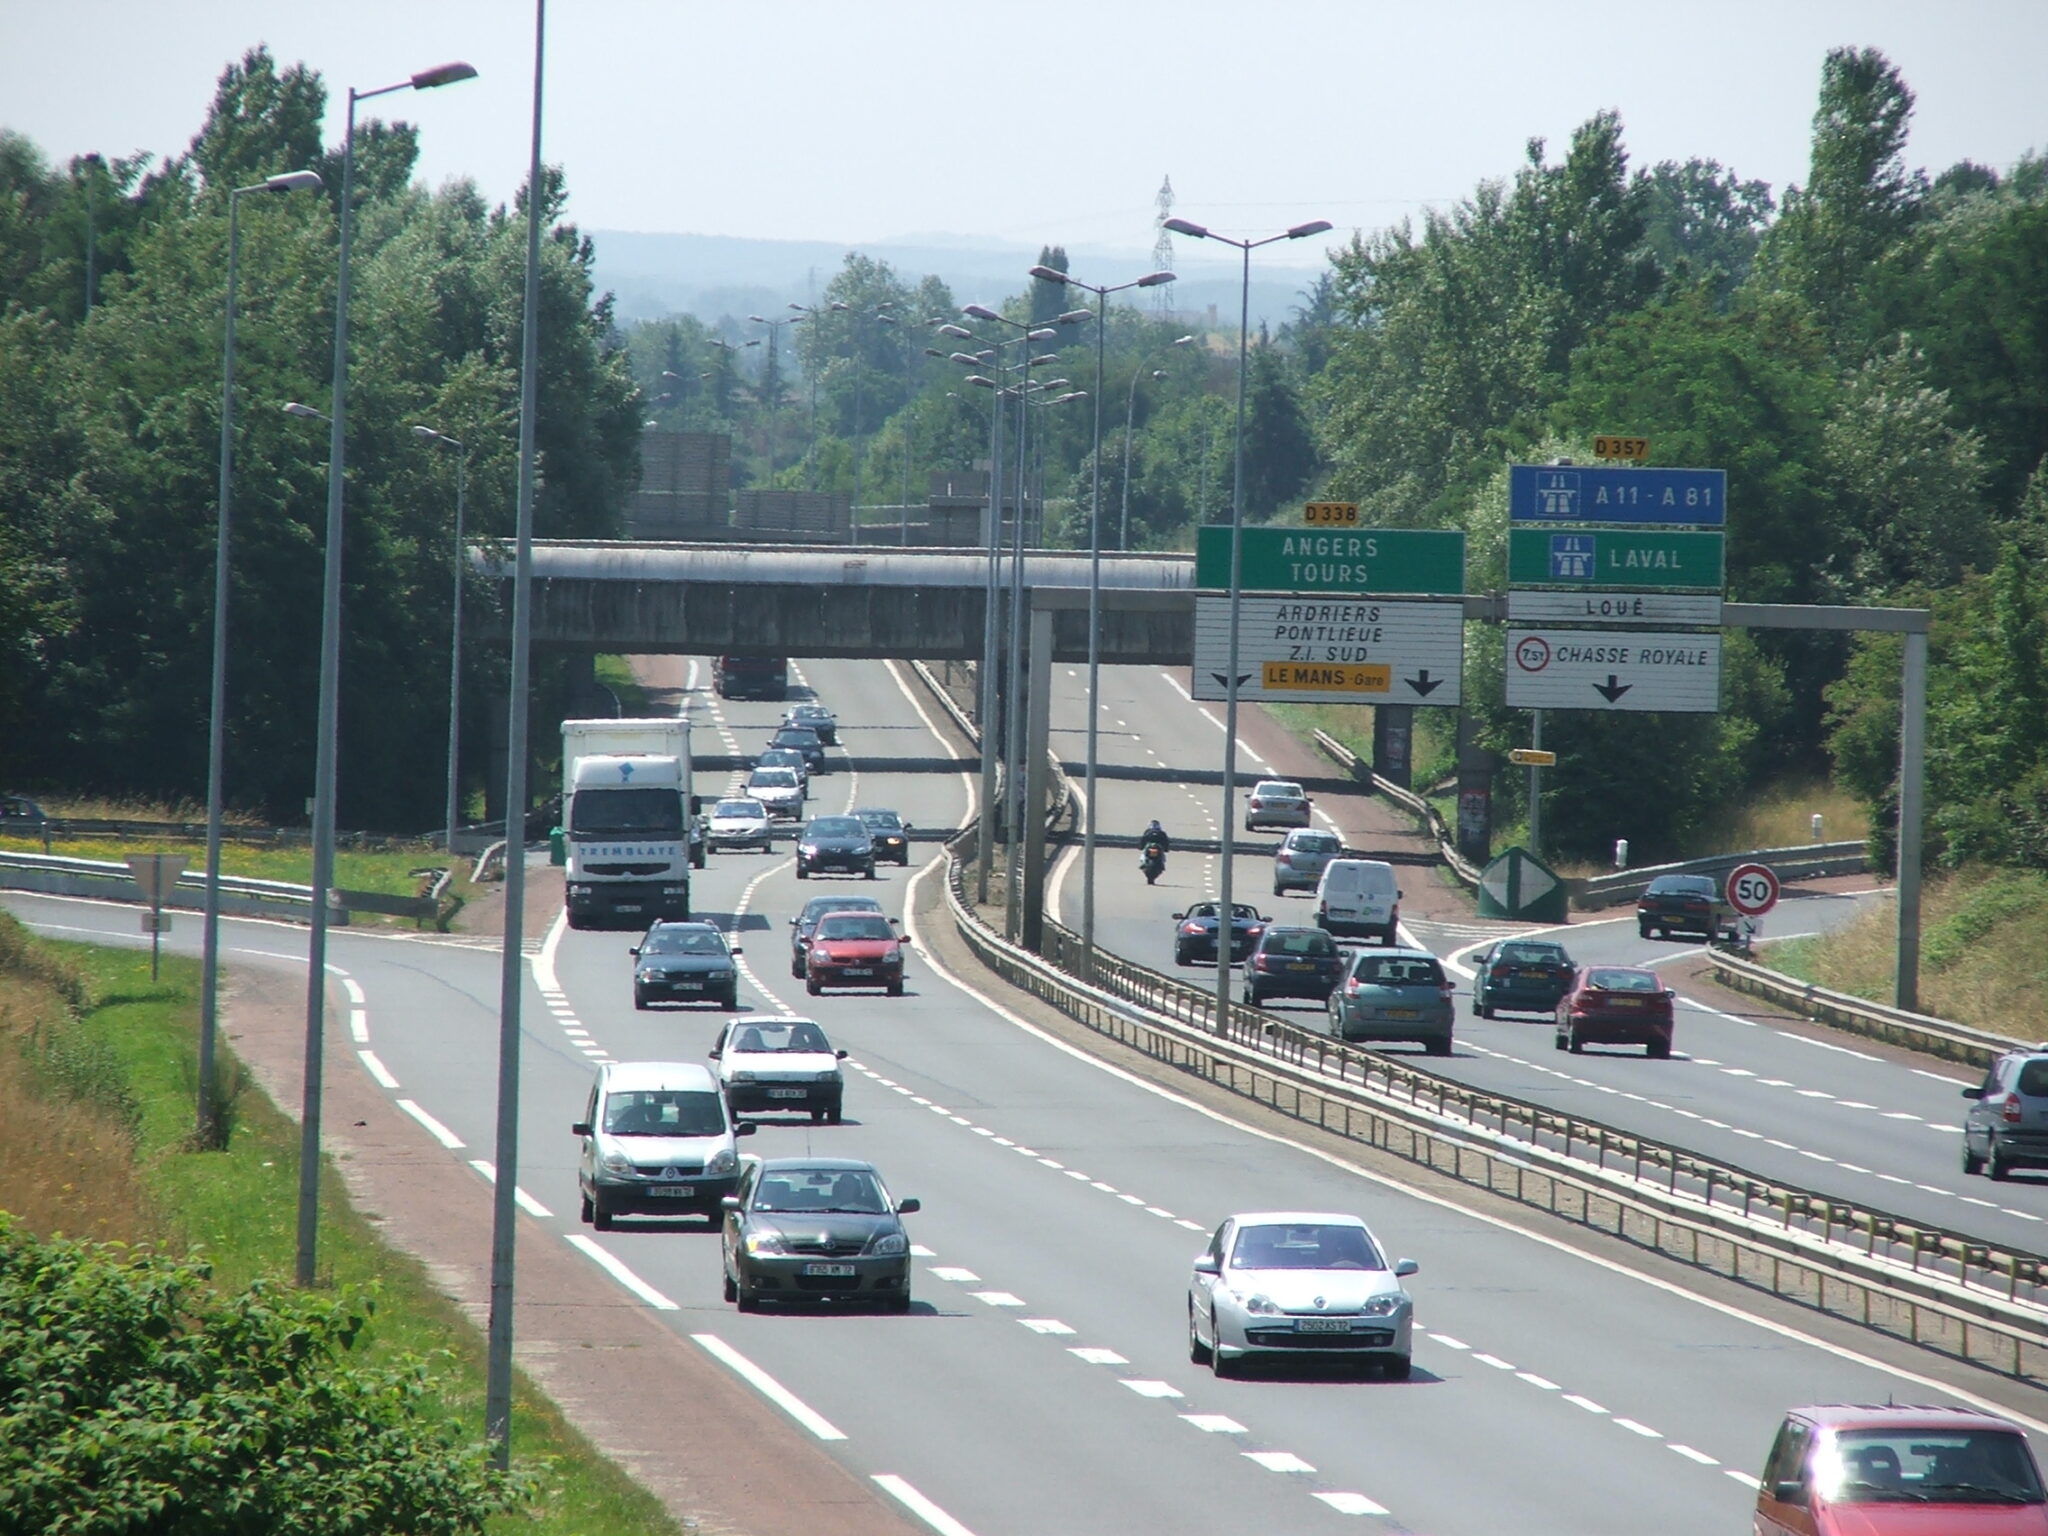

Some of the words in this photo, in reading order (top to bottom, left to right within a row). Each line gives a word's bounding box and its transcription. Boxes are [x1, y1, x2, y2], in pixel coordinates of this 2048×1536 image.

[1283, 538, 1378, 557] ANGERS
[1611, 549, 1682, 569] LAVAL
[1292, 563, 1367, 583] TOURS
[1277, 606, 1380, 622] ARDRIERS
[1587, 598, 1644, 615] LOUÉ
[1275, 626, 1382, 642] PONTLIEUE
[1326, 647, 1367, 662] SUD
[1557, 647, 1629, 663] CHASSE
[1640, 649, 1707, 666] ROYALE
[1269, 669, 1288, 683] LE
[1294, 669, 1345, 684] MANS
[1739, 880, 1768, 901] 50
